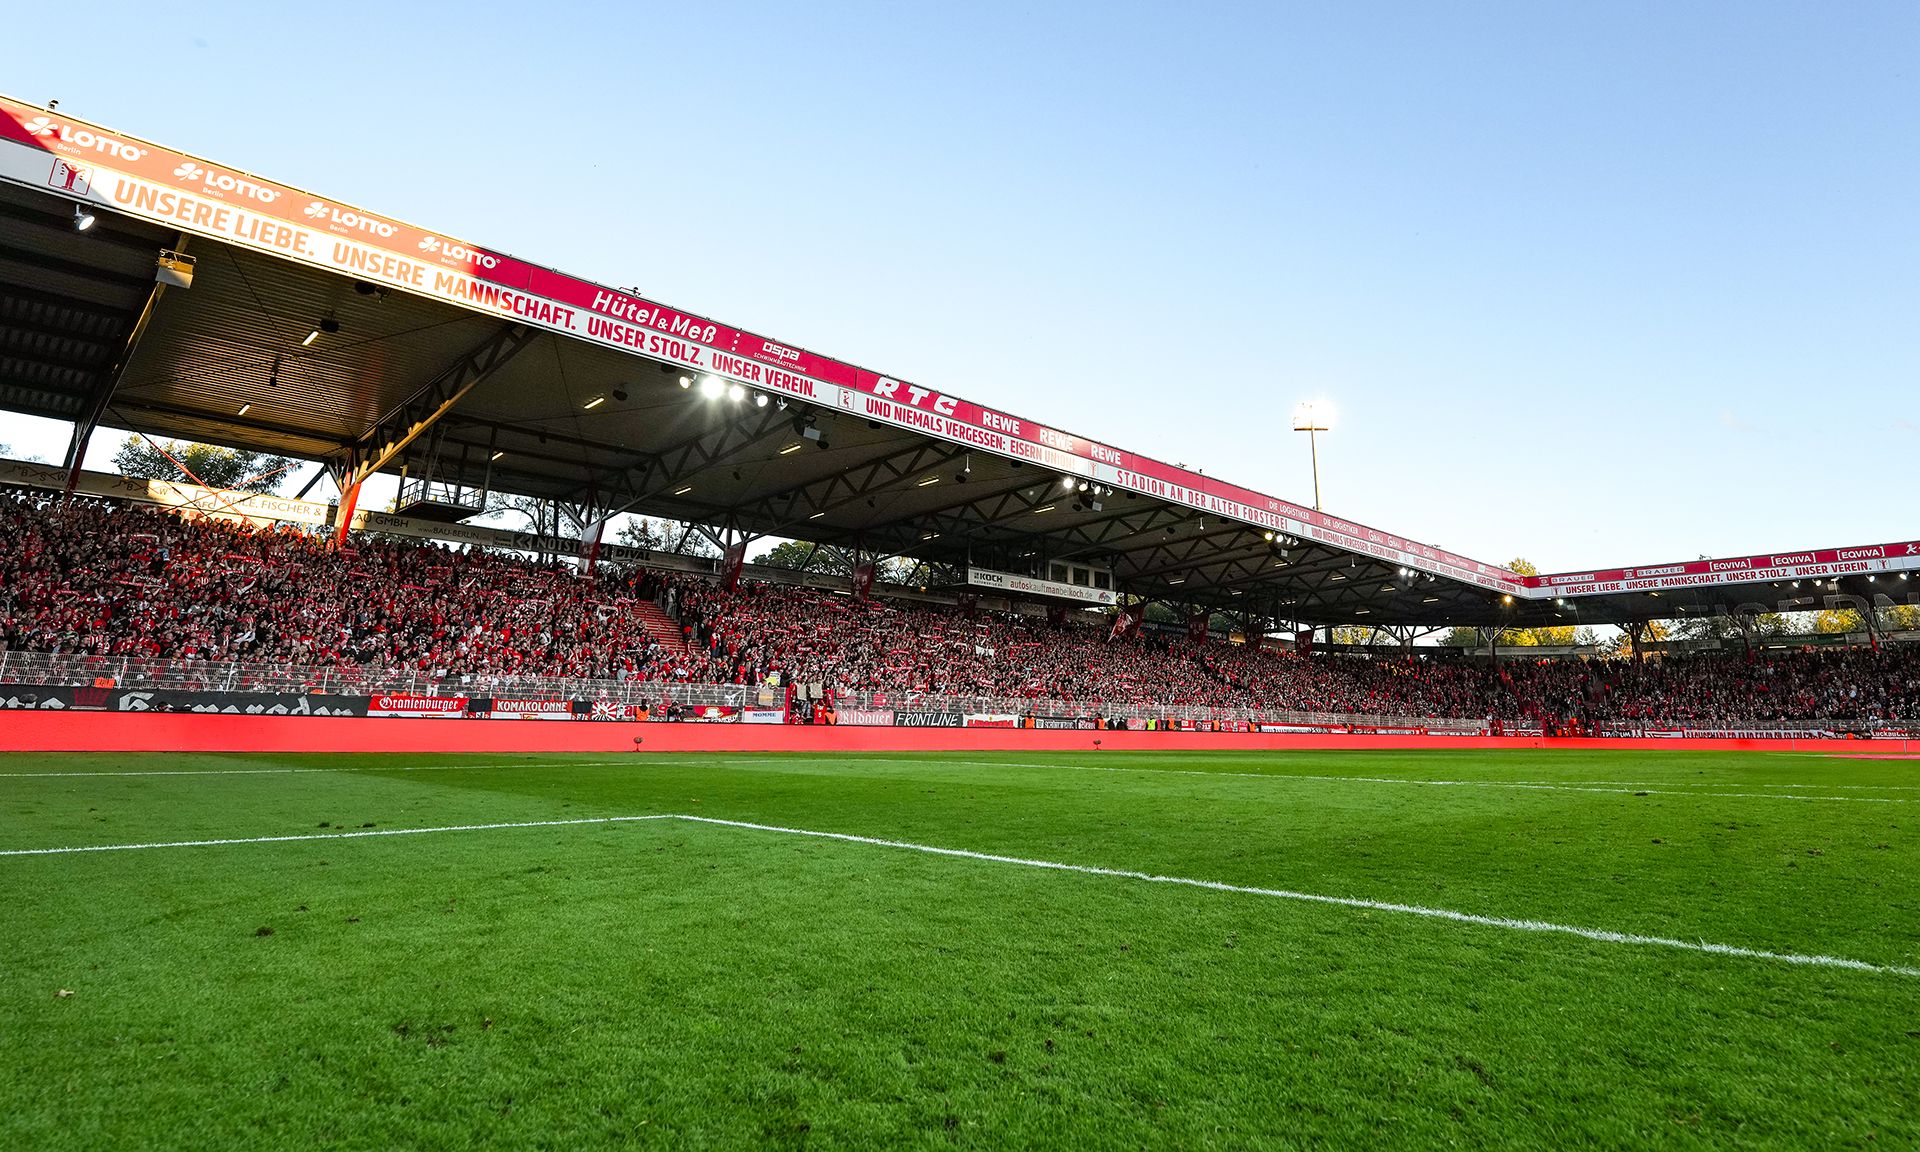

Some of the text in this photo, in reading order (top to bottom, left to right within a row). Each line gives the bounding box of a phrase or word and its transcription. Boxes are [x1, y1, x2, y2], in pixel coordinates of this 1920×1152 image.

[57, 143, 81, 155] Berlin
[114, 179, 817, 398] UNSERE LIEBE. UNSERE MANNSCHAFT. UNSER STOLZ. UNSER VEREIN.
[591, 291, 717, 343] Hütel & Meß
[865, 398, 891, 417] UND
[894, 404, 942, 432] NIEMALS
[945, 420, 1006, 451] VERGESSEN:
[1010, 440, 1042, 460] EISERN
[982, 412, 1020, 435] REWE
[1039, 428, 1073, 451] REWE
[1091, 444, 1121, 465] REWE
[1117, 470, 1165, 496] STADION
[1170, 485, 1183, 501] AN
[1188, 490, 1206, 507] DER
[1210, 498, 1239, 516] ALTEN
[261, 501, 310, 515] FISCHER
[313, 507, 322, 516] &
[375, 516, 409, 527] GMBH
[536, 539, 609, 557] NOTSTM
[980, 572, 1003, 582] KOCH
[1566, 562, 1872, 594] UNSERE LIEBE. UNSERE MANNSCHAFT. UNSER STOLZ. UNSER VEREIN.
[1637, 567, 1684, 576] BRAUER
[496, 700, 568, 712] KOMAKOLONNE
[895, 712, 958, 727] FRONTLINE
